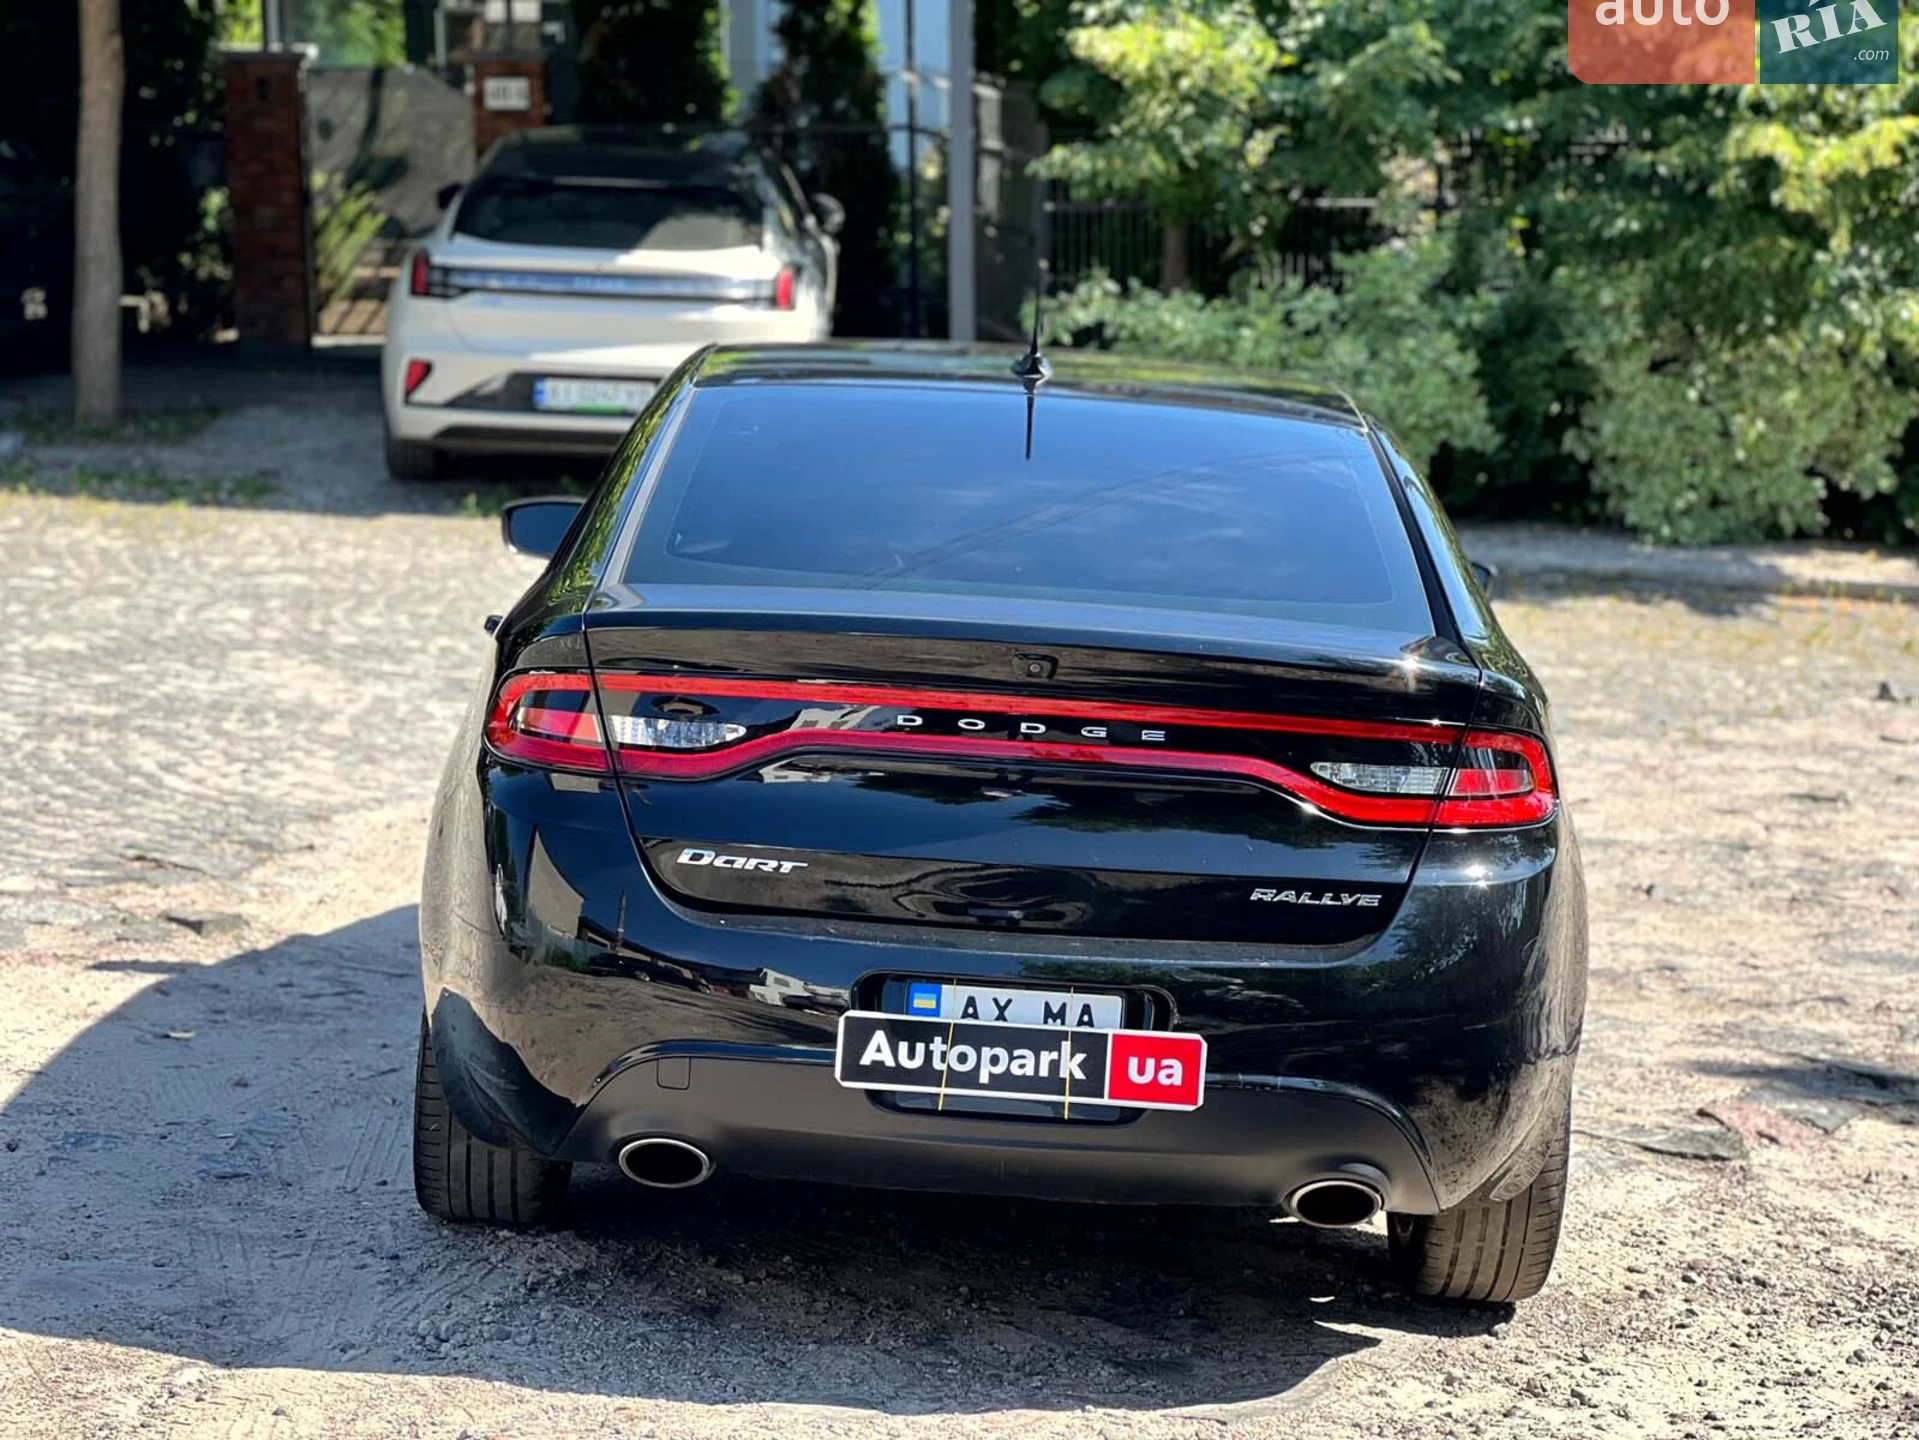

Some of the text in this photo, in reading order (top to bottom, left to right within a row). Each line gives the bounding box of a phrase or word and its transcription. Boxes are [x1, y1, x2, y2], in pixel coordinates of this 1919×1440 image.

[897, 714, 1166, 742] DODGE
[1249, 887, 1383, 907] RALLYE
[959, 995, 1095, 1029] AX MA
[858, 1029, 1184, 1087] Autopark ua
